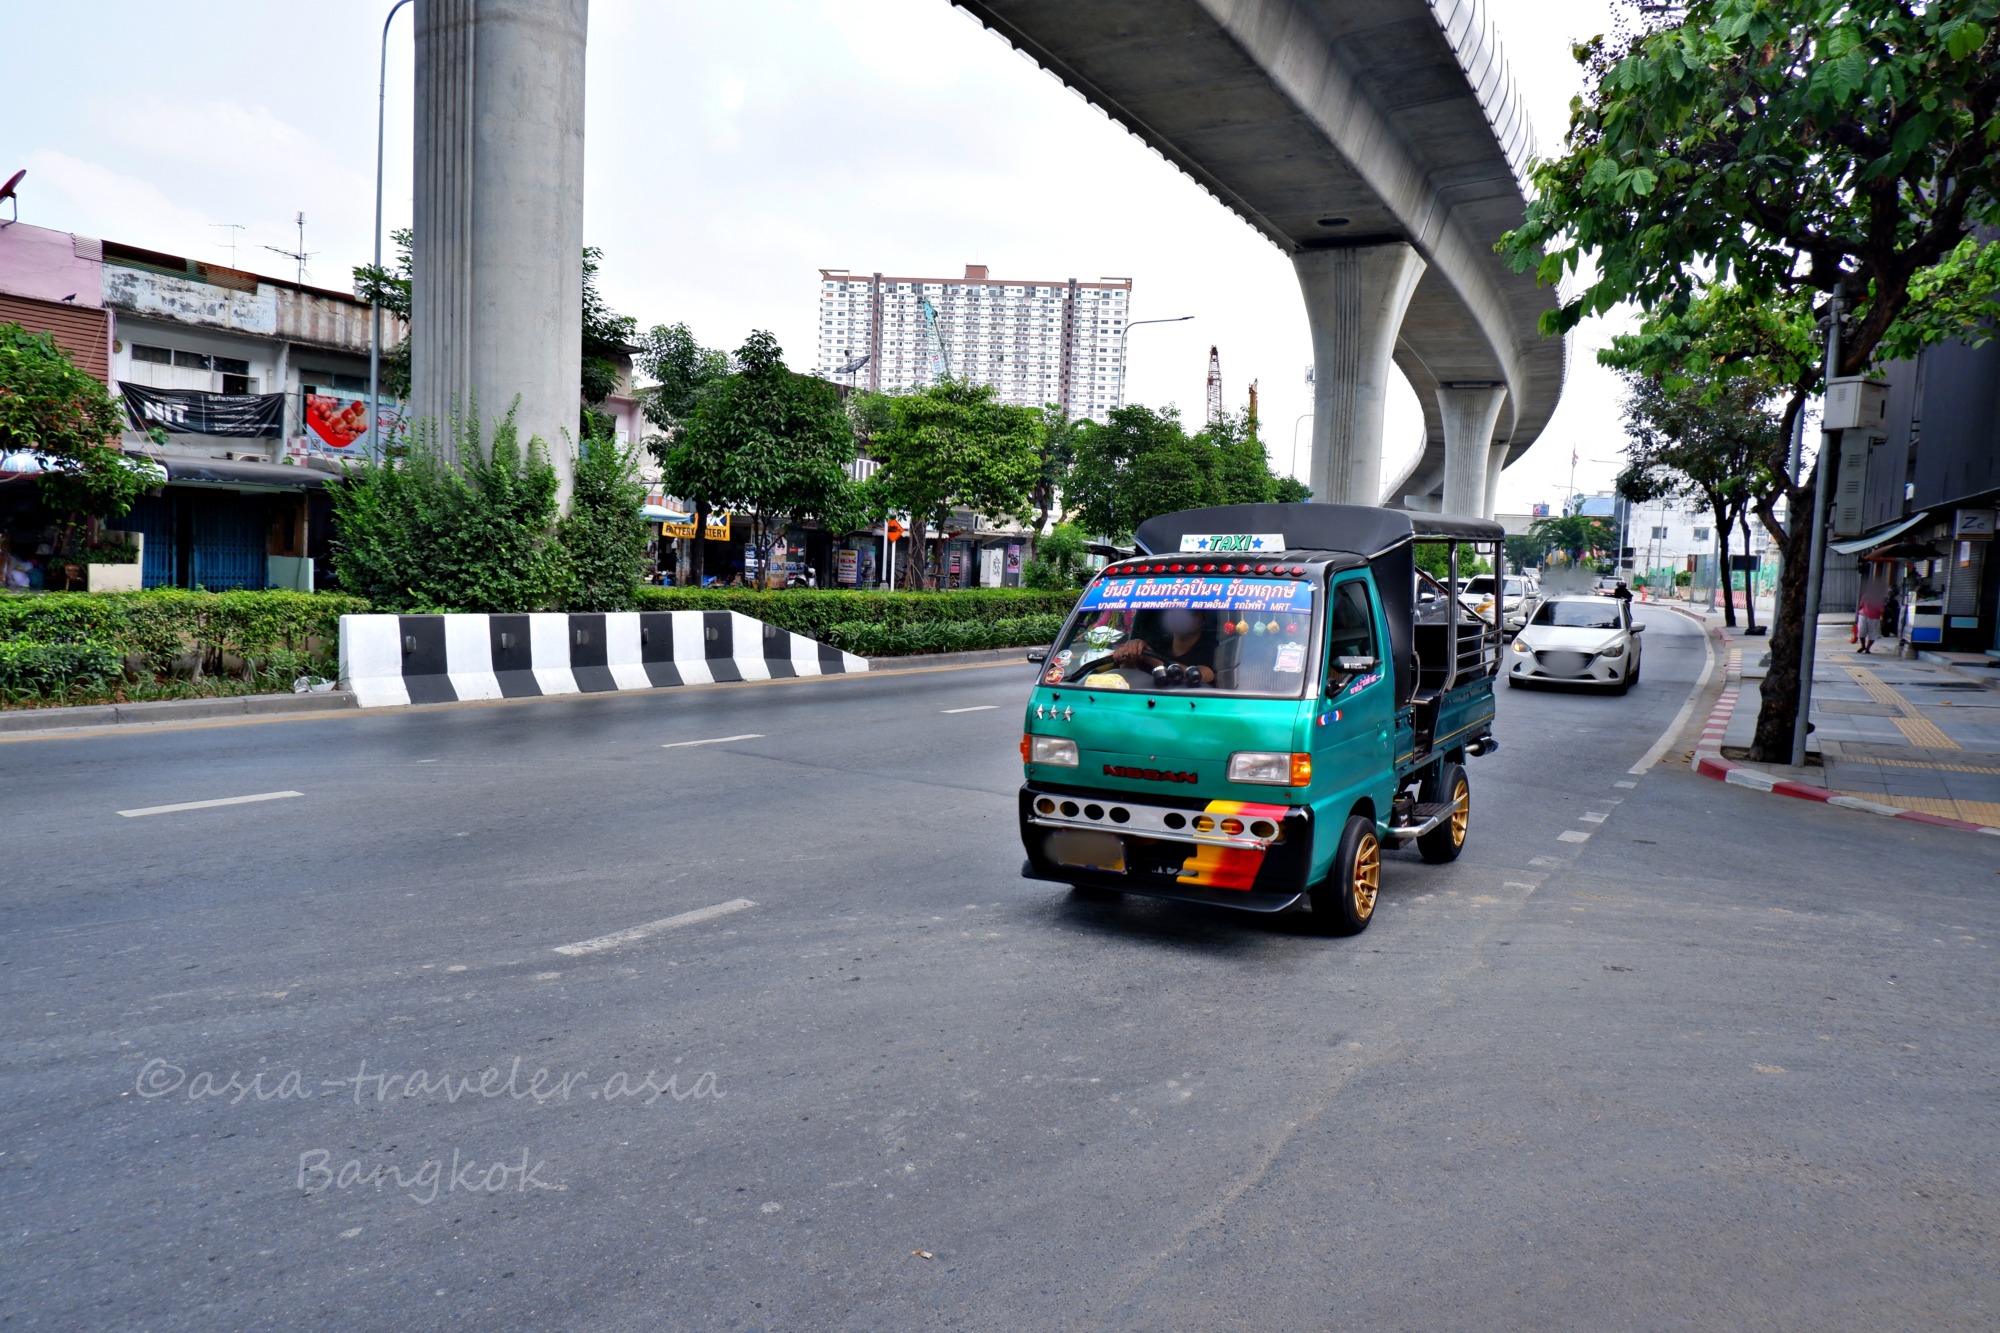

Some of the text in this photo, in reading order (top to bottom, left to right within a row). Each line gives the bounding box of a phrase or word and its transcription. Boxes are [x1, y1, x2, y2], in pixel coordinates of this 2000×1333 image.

[1209, 535, 1253, 551] TAXI
[1226, 578, 1299, 601] ชัยพฤกษ์
[1270, 602, 1291, 611] MRT
[1103, 764, 1198, 784] NISSAN
